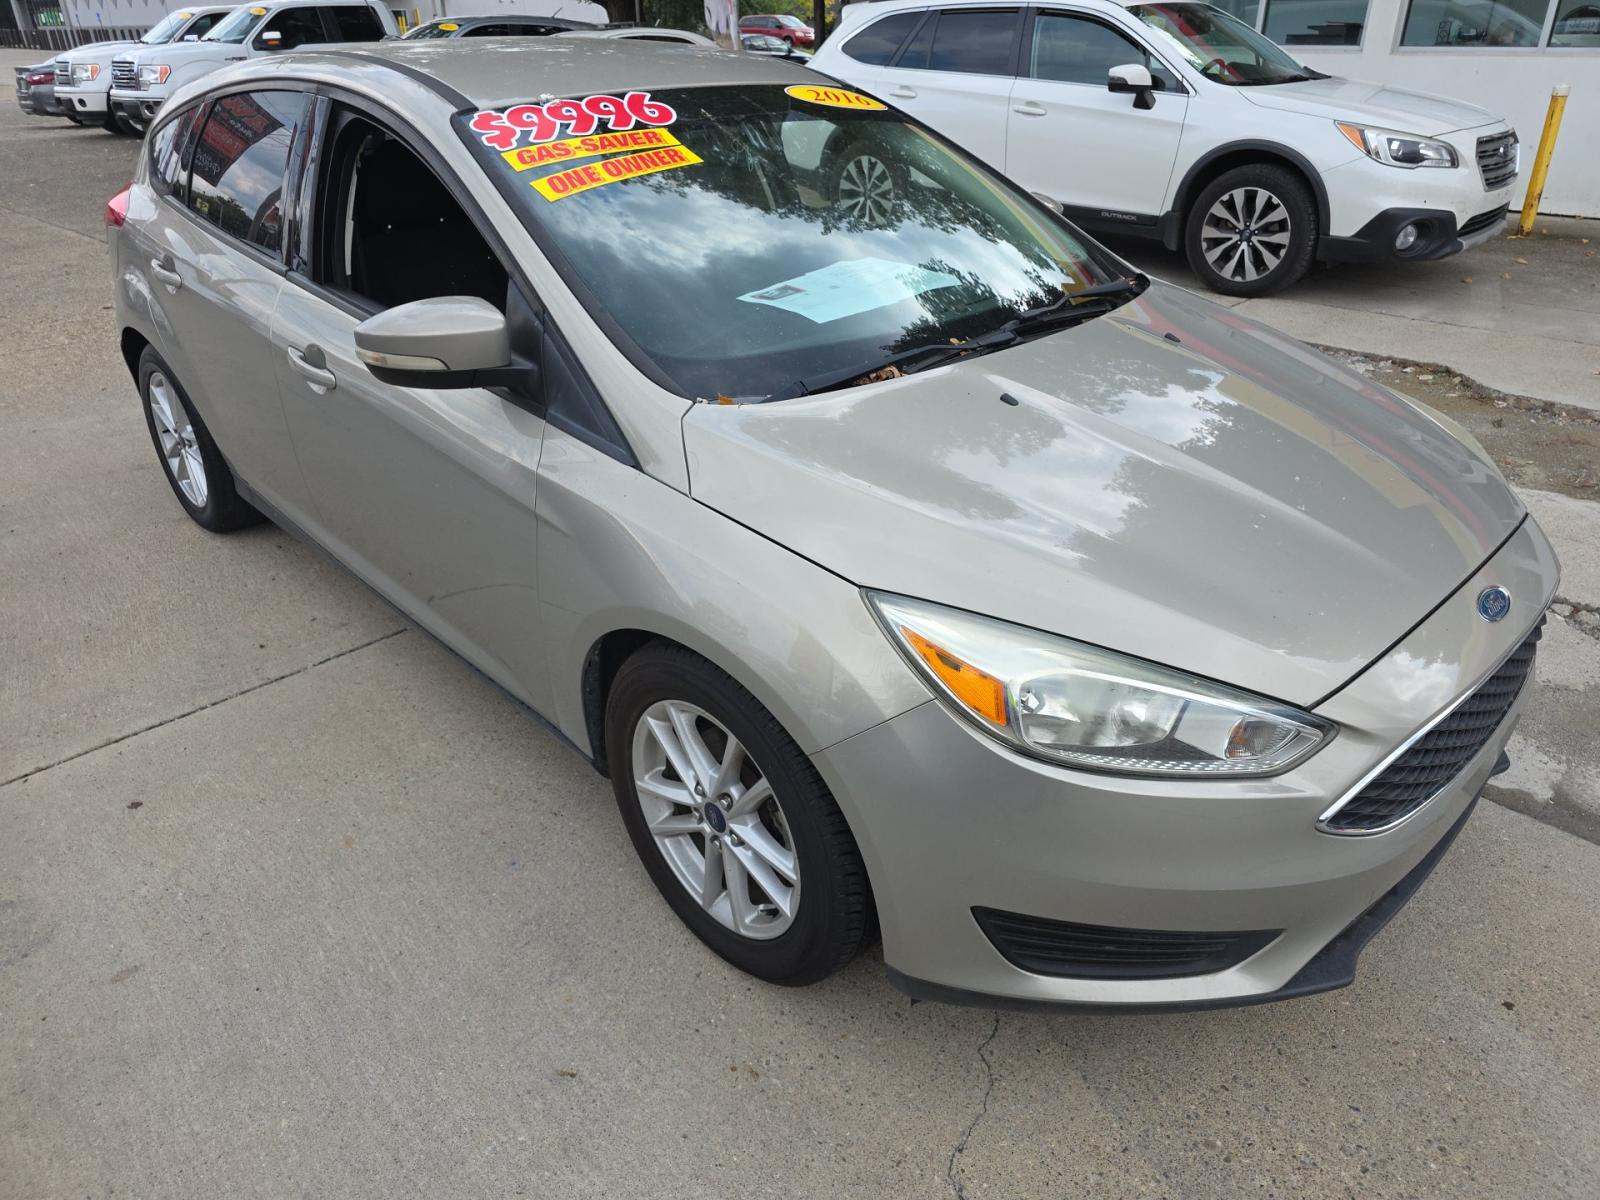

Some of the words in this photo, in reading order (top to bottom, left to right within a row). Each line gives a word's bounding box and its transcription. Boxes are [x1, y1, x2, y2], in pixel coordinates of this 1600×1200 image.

[807, 89, 871, 106] 2016
[470, 92, 676, 150] $9996
[516, 130, 666, 165] GAS-SAVER
[546, 165, 601, 194] ONE
[601, 147, 687, 177] OWNER
